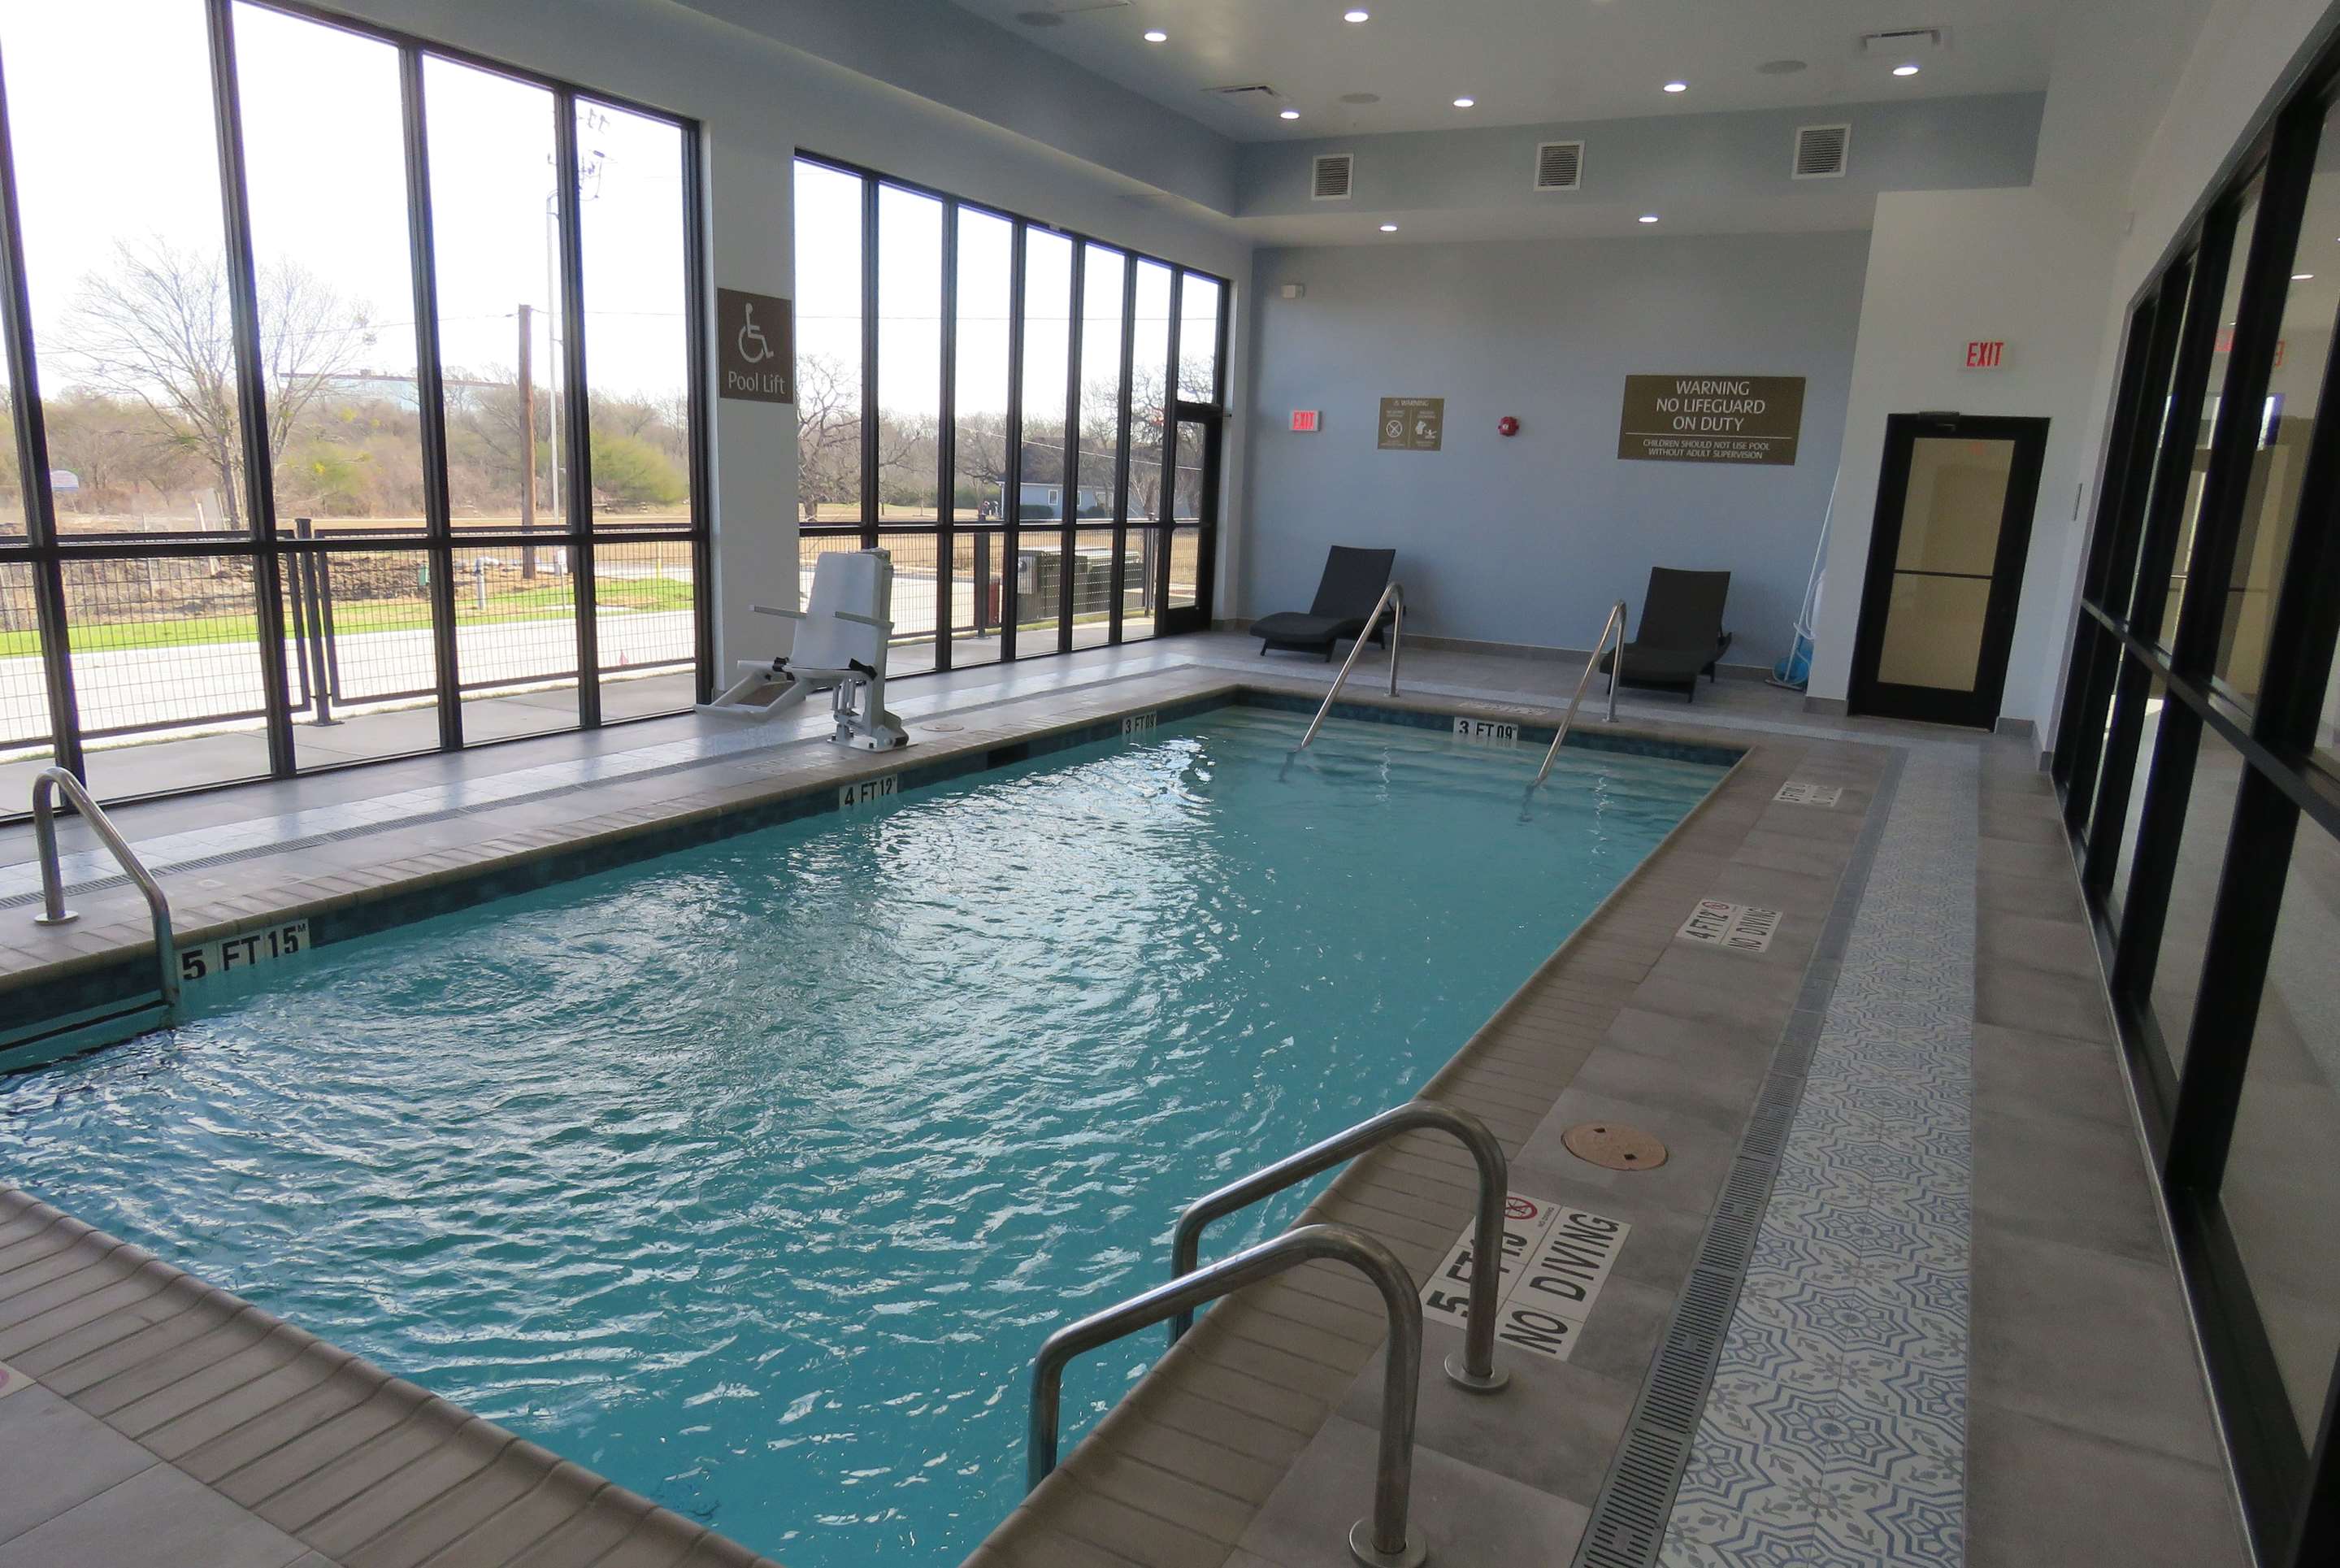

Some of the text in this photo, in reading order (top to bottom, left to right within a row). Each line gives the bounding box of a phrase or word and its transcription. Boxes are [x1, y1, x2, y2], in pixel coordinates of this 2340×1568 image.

[1967, 342, 2004, 366] EXIT
[728, 371, 786, 394] Pool Lift
[1676, 380, 1750, 396] WARNING
[1656, 398, 1765, 414] NO LIFEGUARD
[1673, 416, 1744, 432] ON DUTY
[1643, 439, 1770, 451] CHILDREN SHOULD NOT USE POOL
[1648, 448, 1763, 459] WITHOUT ADULT SUPERVISION
[1126, 719, 1131, 734] 3
[1135, 716, 1144, 730] FT
[1459, 720, 1469, 735] 3
[1476, 723, 1494, 736] FT
[844, 787, 854, 806] 4
[861, 782, 877, 803] FT
[1689, 919, 1724, 932] FT
[1728, 908, 1777, 951] NO DIVING
[1686, 930, 1717, 939] 4
[182, 949, 206, 980] 5
[222, 936, 260, 971] FT
[1500, 1213, 1619, 1354] NO DIVING
